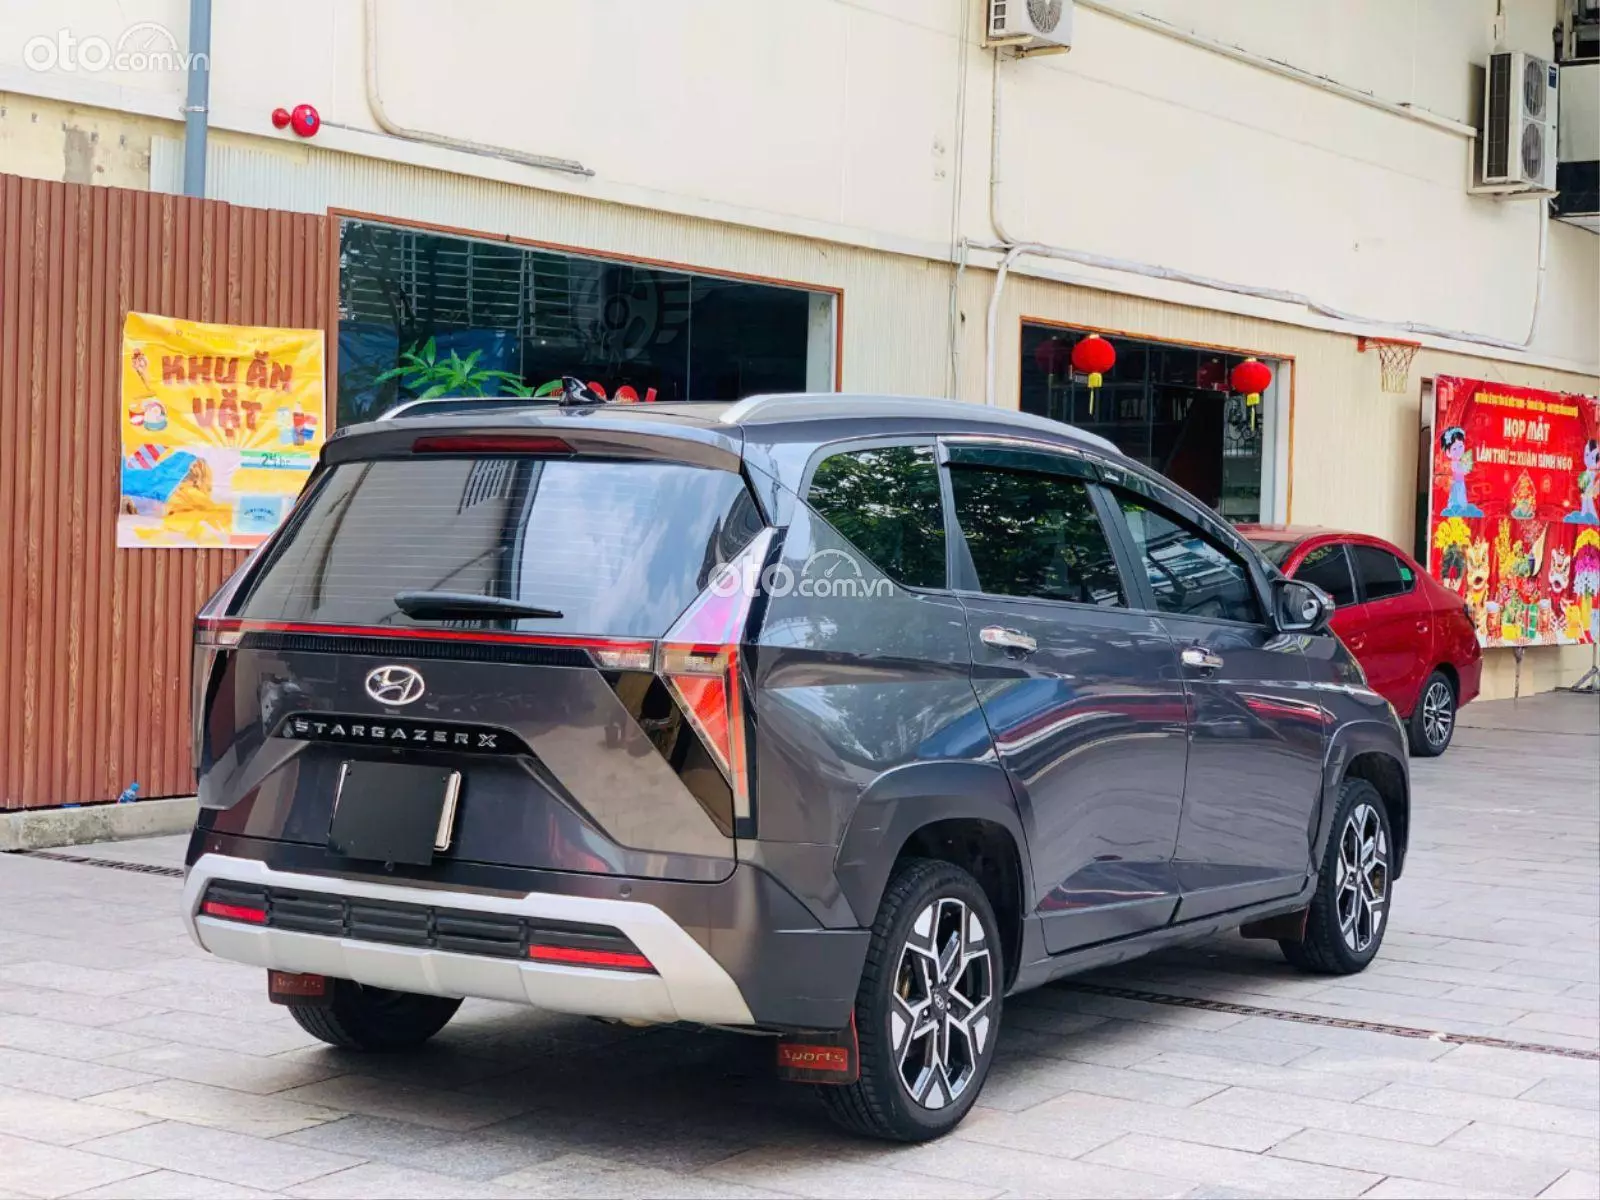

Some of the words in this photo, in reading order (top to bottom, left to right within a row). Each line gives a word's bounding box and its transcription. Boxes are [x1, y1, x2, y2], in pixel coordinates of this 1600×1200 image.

[161, 354, 240, 386] KHU
[245, 350, 293, 391] ĂN
[192, 389, 263, 437] VẶT
[294, 719, 470, 745] STARGAZER
[477, 732, 498, 748] X
